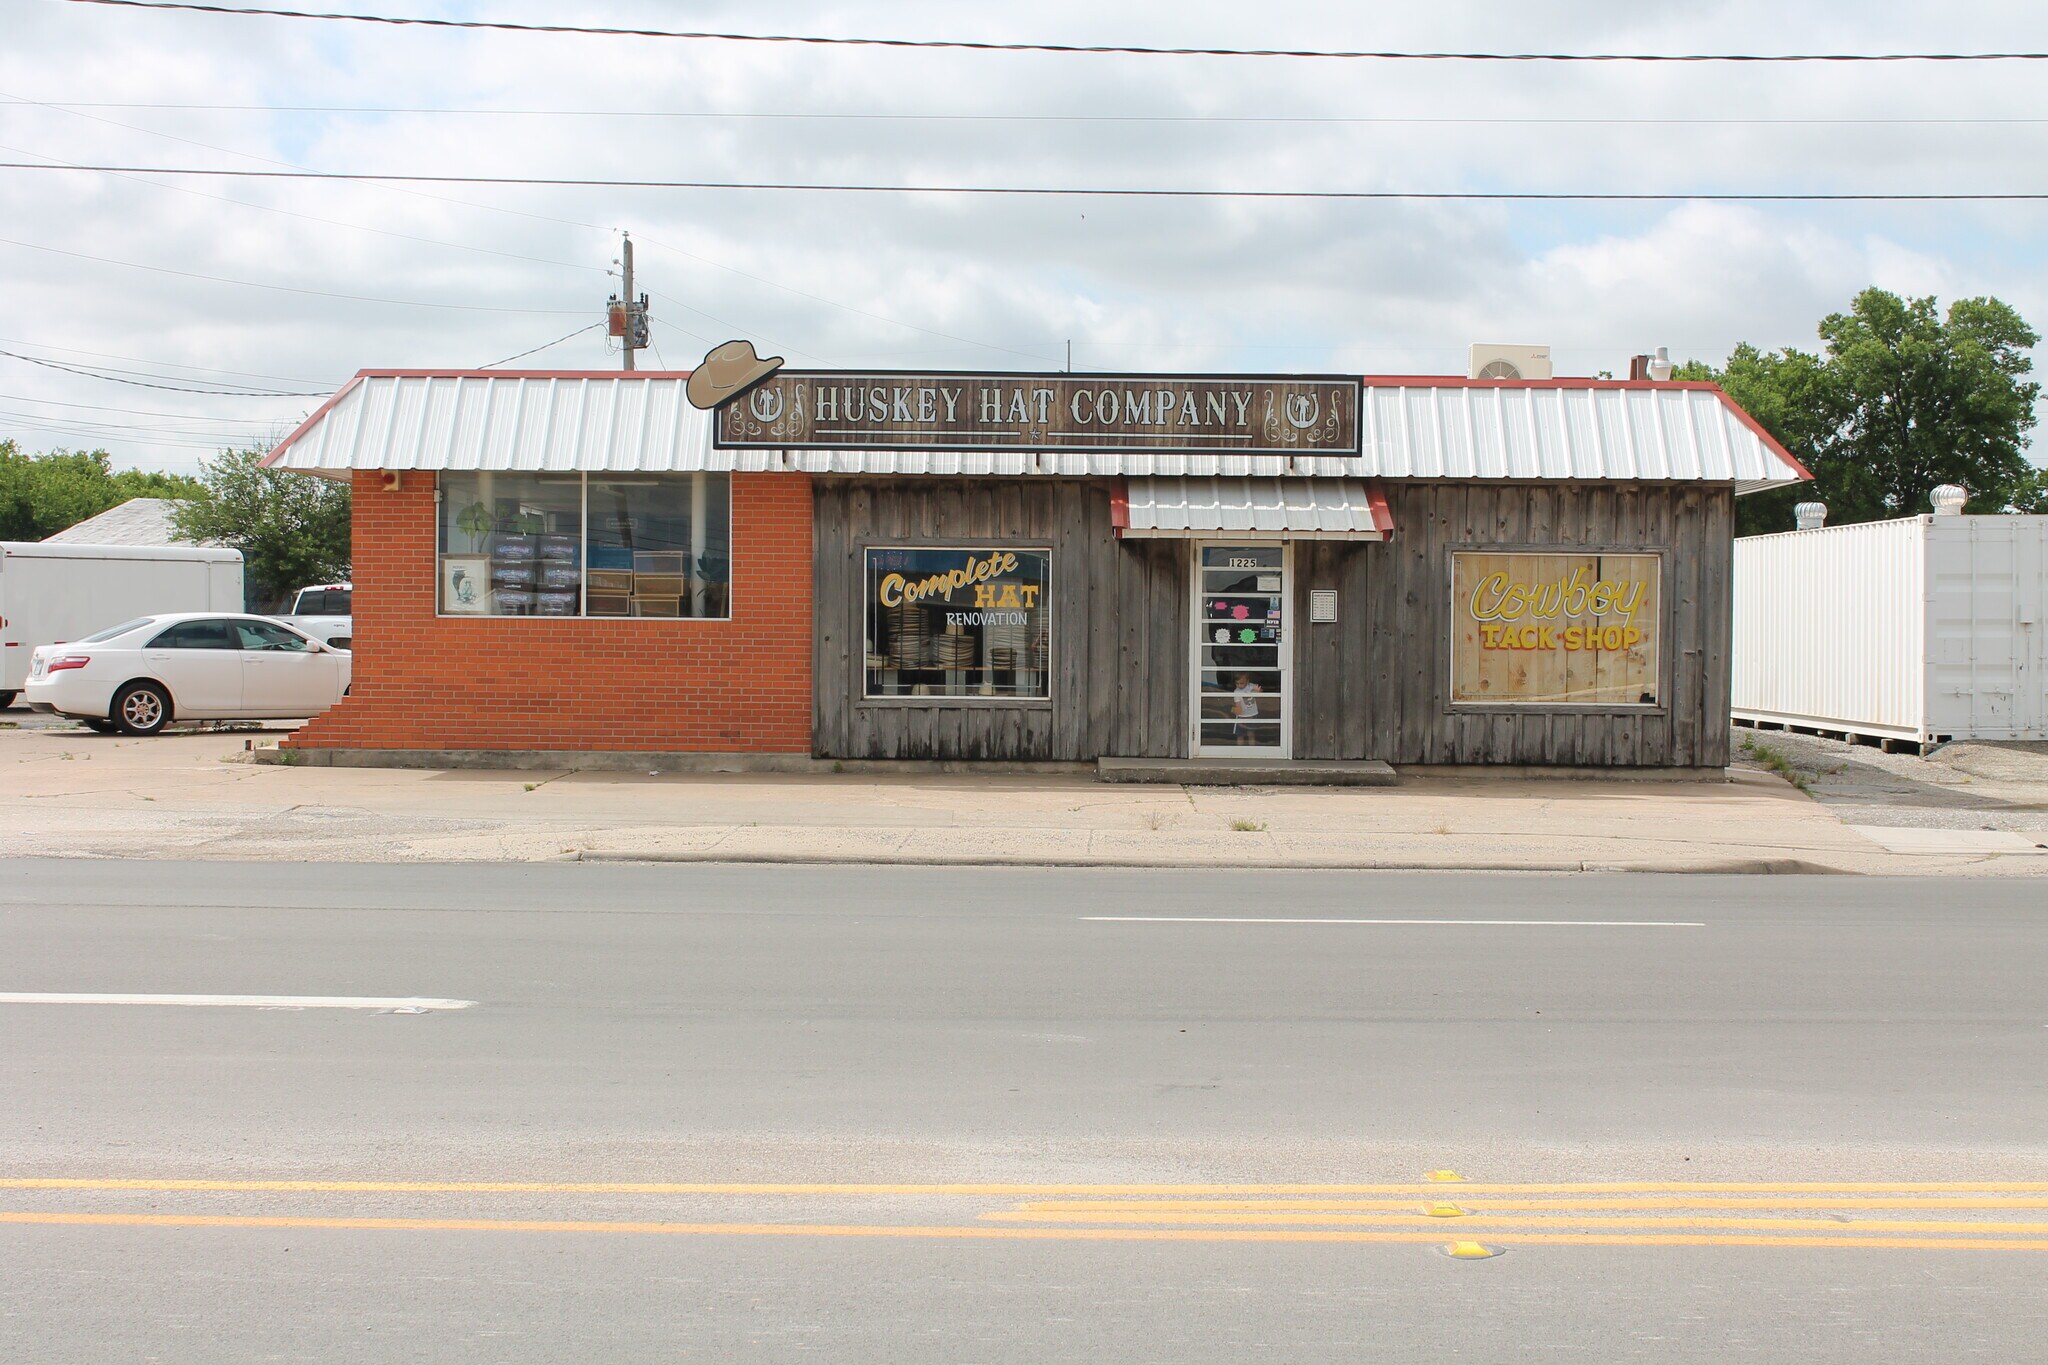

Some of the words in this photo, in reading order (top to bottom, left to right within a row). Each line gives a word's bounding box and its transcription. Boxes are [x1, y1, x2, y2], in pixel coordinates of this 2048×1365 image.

[815, 386, 962, 423] HUSKEY
[979, 387, 1055, 424] HAT
[1070, 389, 1253, 426] COMPANY
[1231, 558, 1256, 568] 1225
[880, 551, 1019, 607] Complete
[974, 584, 1039, 608] HAT
[1470, 566, 1647, 628] Cowboy
[945, 612, 1028, 626] RENOVATION
[1479, 624, 1556, 650] TACK
[1564, 625, 1641, 651] SHOP
